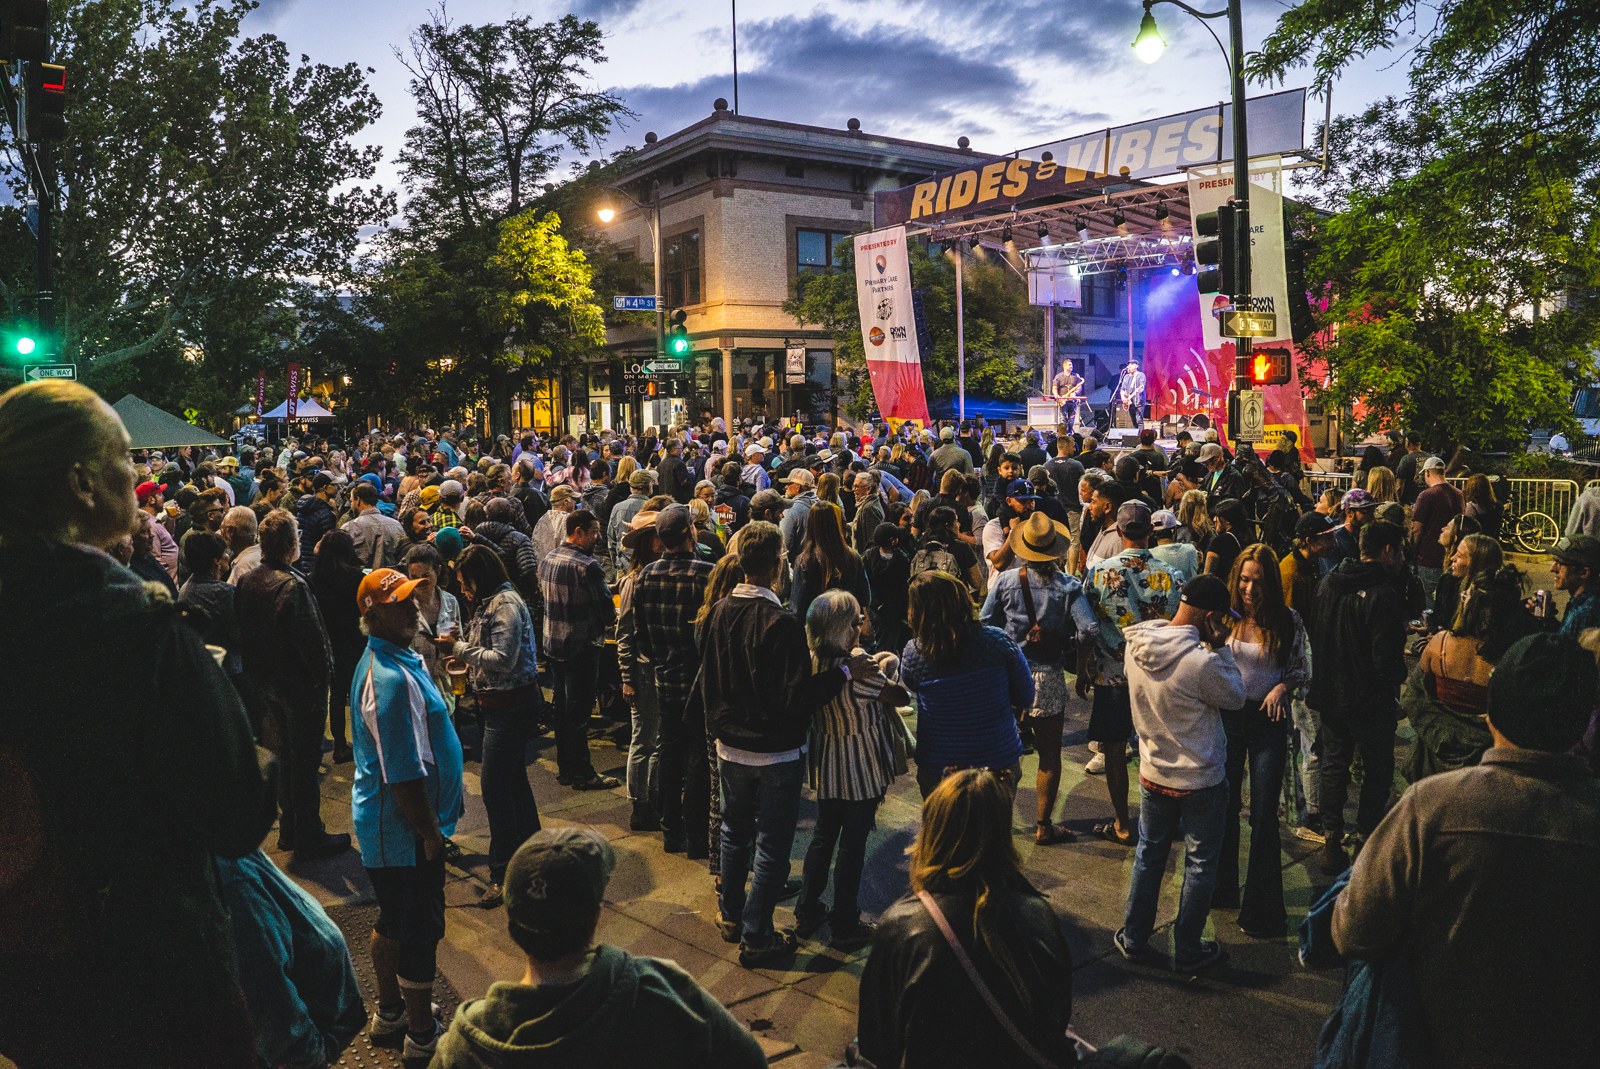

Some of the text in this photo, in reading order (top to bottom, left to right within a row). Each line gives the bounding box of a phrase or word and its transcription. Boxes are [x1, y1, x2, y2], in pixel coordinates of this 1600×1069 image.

[910, 115, 1223, 219] RIDES & VIBES
[1199, 178, 1234, 190] PRESEN
[1250, 225, 1264, 233] ARE
[860, 240, 890, 251] PRESENTED
[864, 278, 887, 286] PRIMARY
[632, 299, 645, 308] 4th
[1252, 297, 1274, 306] OWN
[1240, 320, 1272, 330] ONE WAY
[40, 369, 54, 377] ONE
[289, 370, 298, 398] SWISS
[625, 385, 637, 394] EYE
